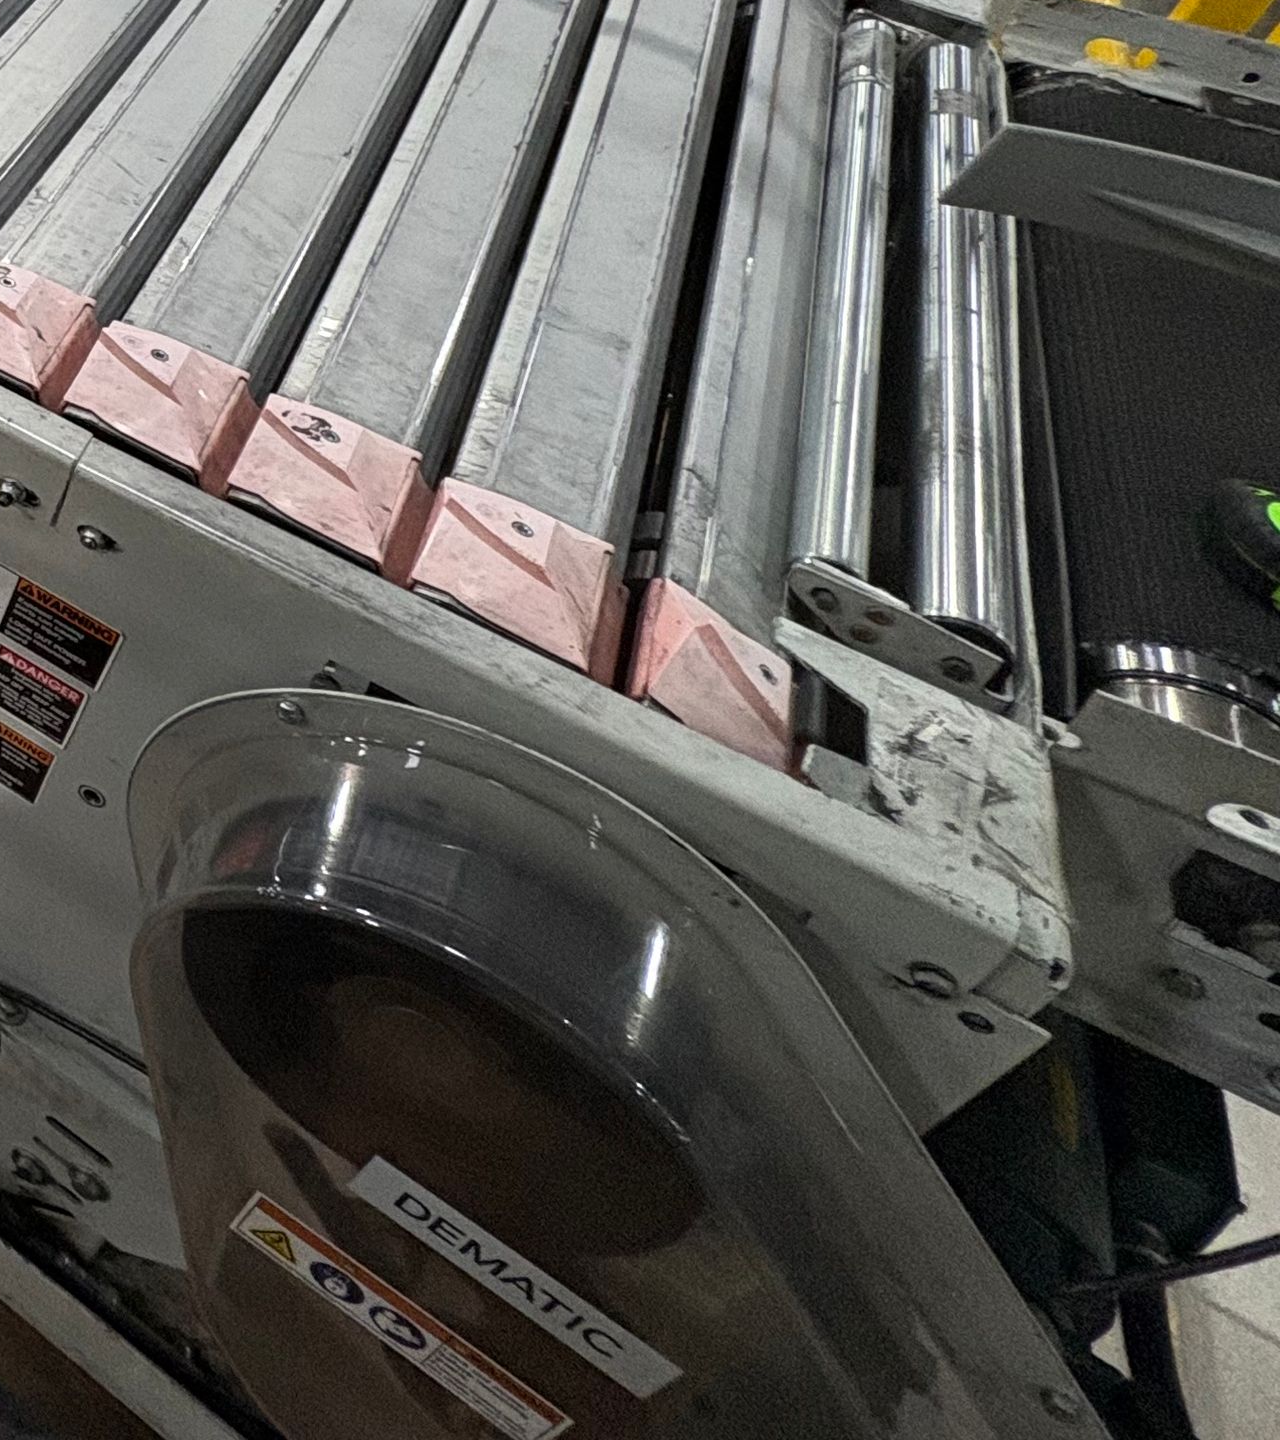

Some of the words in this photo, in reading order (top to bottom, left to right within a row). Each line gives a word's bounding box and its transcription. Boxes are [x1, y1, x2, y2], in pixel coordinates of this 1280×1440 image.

[34, 586, 113, 640] WARNING
[16, 658, 81, 702] DANGER
[394, 1191, 624, 1359] DEMATIC
